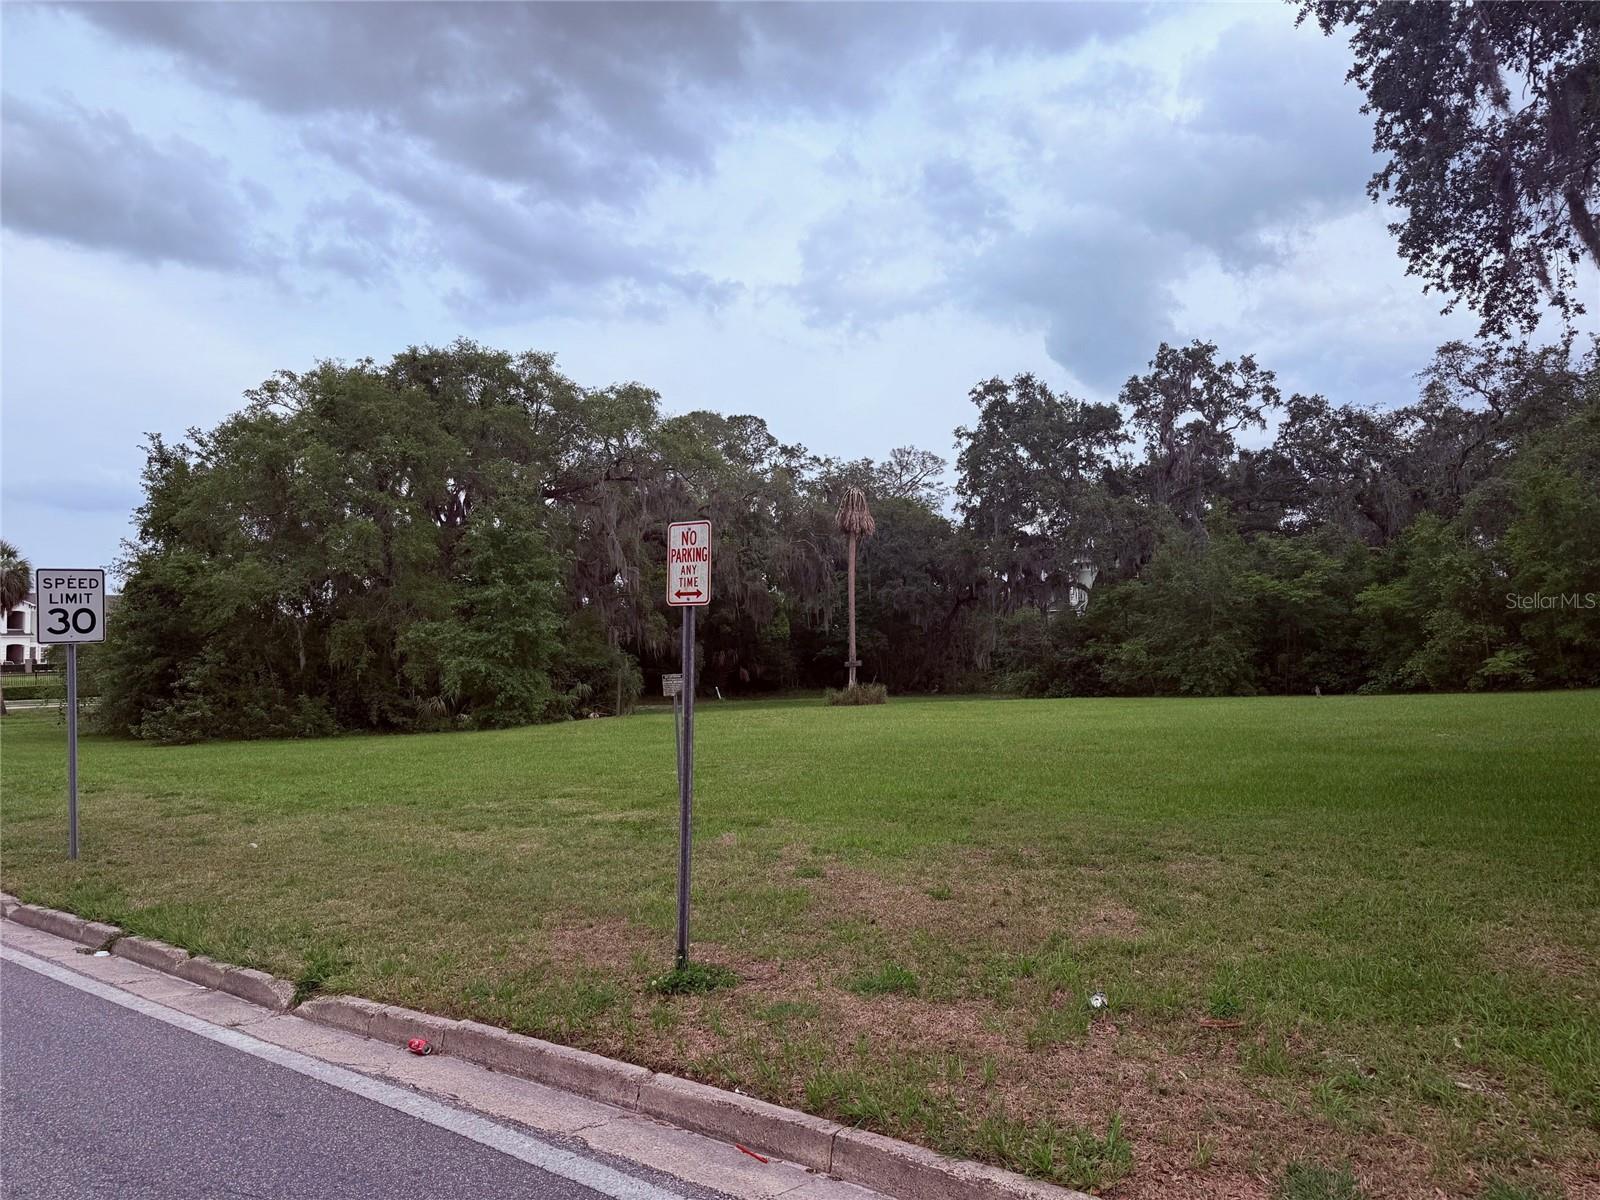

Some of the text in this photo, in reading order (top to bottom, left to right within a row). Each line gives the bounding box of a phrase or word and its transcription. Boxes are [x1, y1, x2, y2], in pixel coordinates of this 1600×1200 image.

[681, 530, 697, 546] NO
[671, 547, 708, 563] PARKING
[680, 565, 697, 575] ANY
[43, 578, 99, 589] SPEED
[678, 577, 698, 587] TIME
[49, 593, 93, 604] LIMIT
[47, 607, 97, 635] 30
